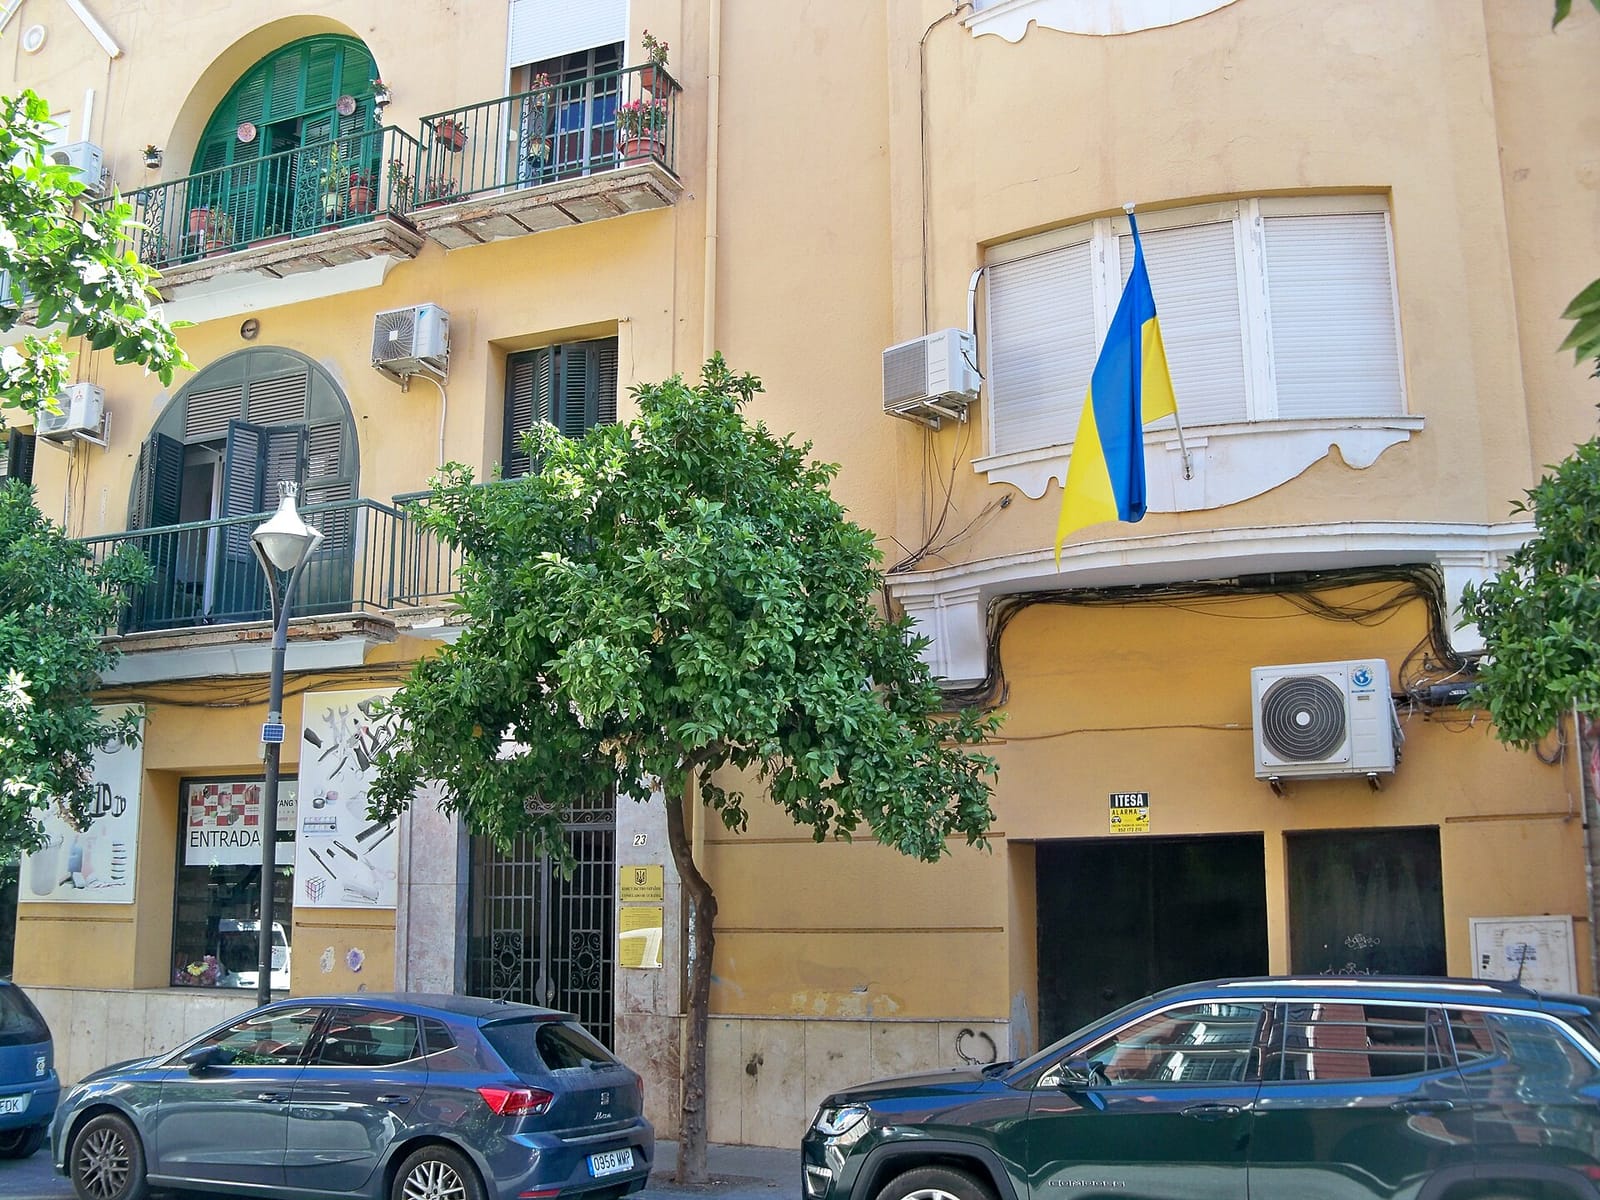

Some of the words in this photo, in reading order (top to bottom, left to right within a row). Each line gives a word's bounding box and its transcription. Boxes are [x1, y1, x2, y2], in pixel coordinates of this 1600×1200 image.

[1114, 793, 1144, 807] ITESA
[1112, 808, 1138, 816] ALARMA
[190, 829, 261, 848] ENTRADA
[634, 834, 647, 846] 23
[593, 1153, 616, 1171] 0956
